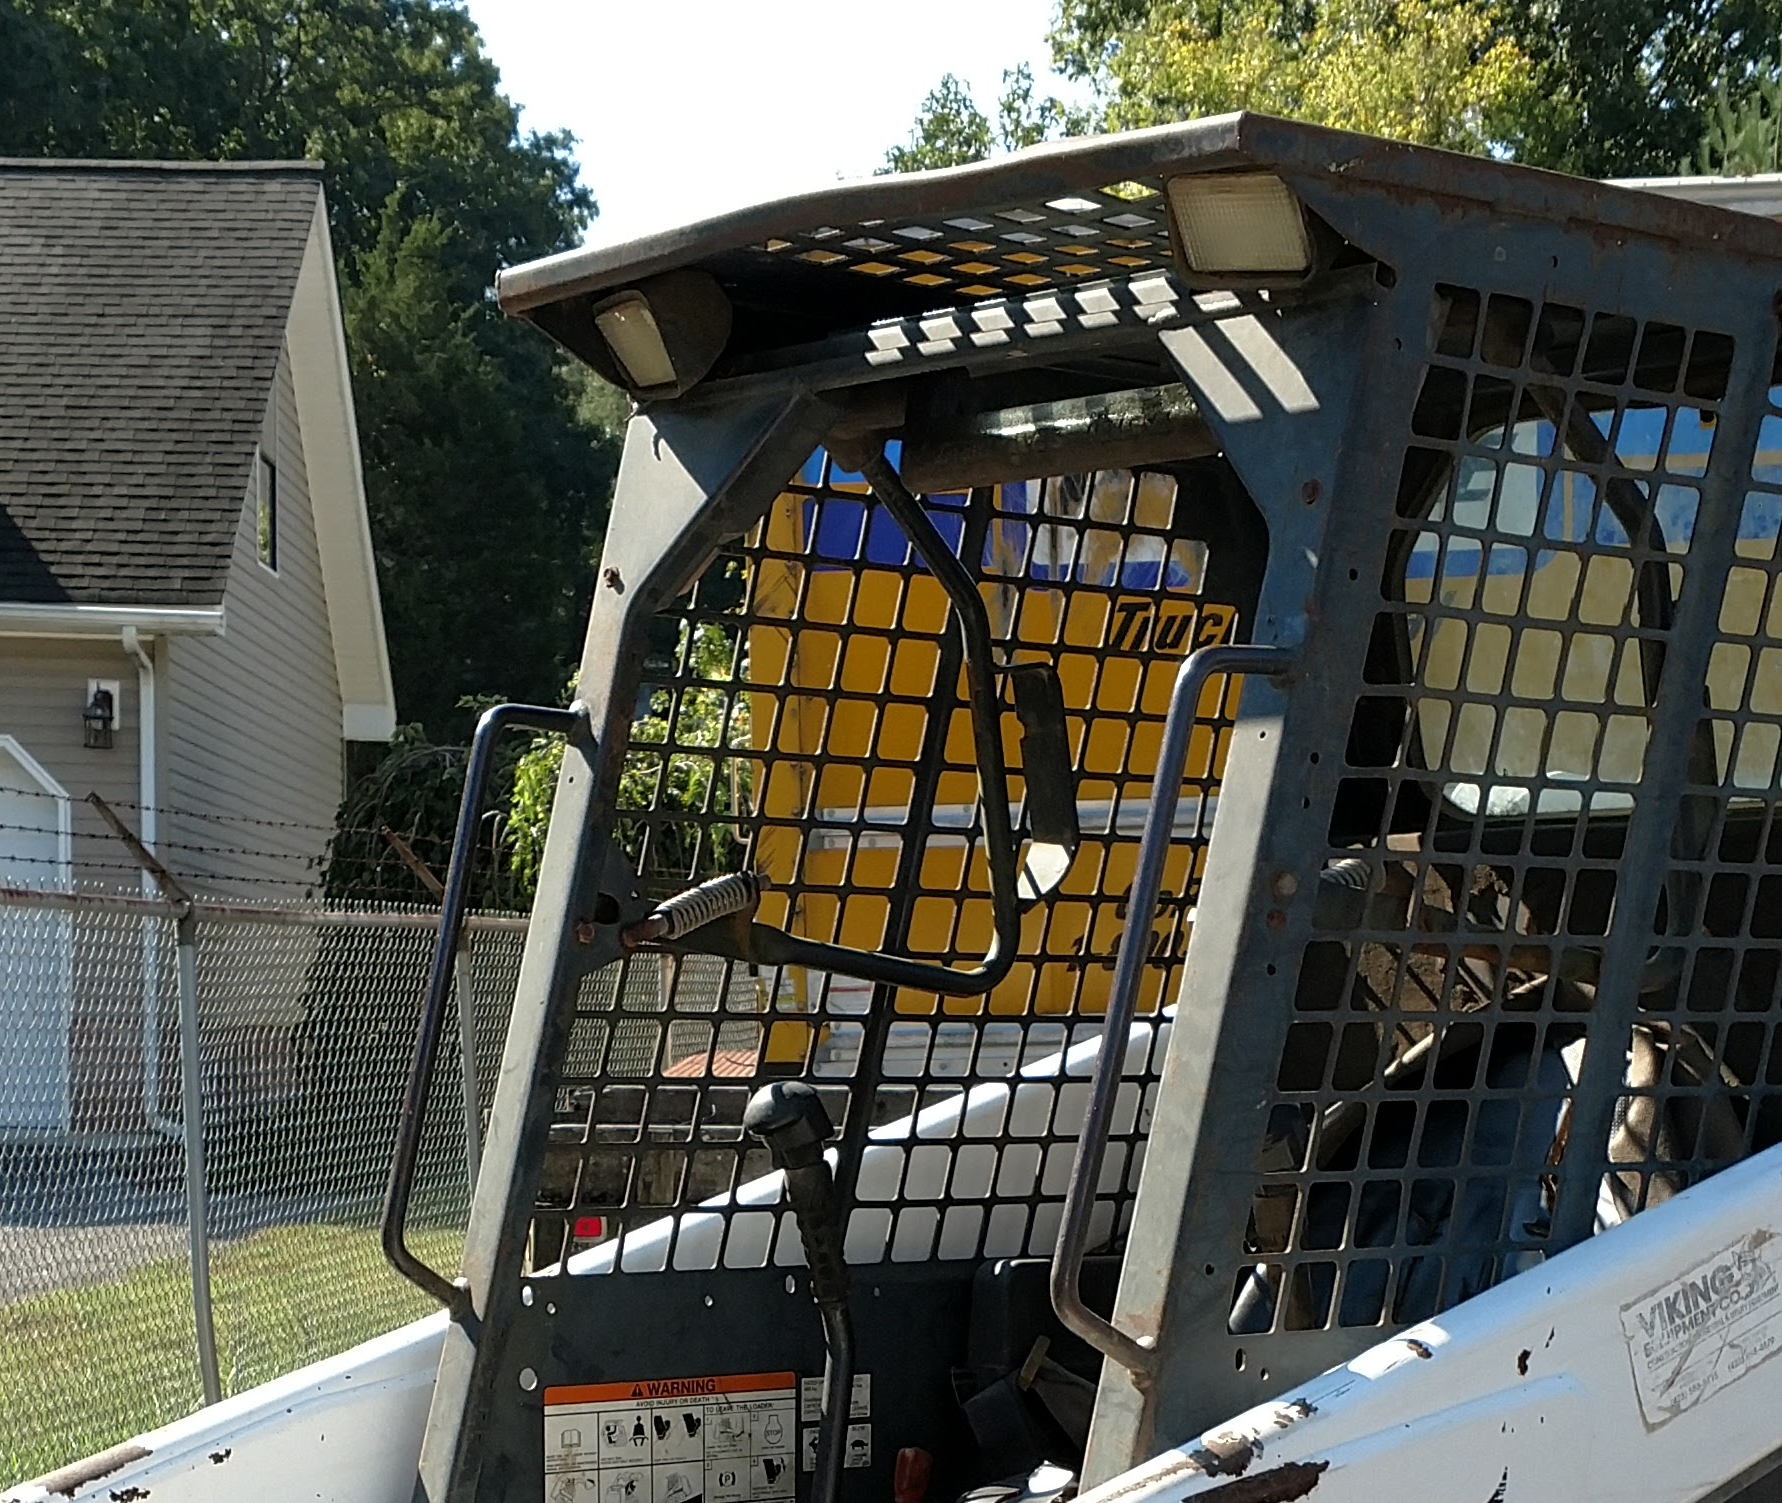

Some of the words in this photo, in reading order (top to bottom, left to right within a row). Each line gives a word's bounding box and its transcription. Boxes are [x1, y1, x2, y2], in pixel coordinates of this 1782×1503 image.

[1110, 601, 1235, 651] Truc
[1637, 1264, 1736, 1338] VIKING
[1643, 1301, 1721, 1358] EUIPMENT
[636, 1400, 655, 1408] AVOID
[656, 1398, 678, 1407] INJURY
[647, 1379, 716, 1396] WARNING
